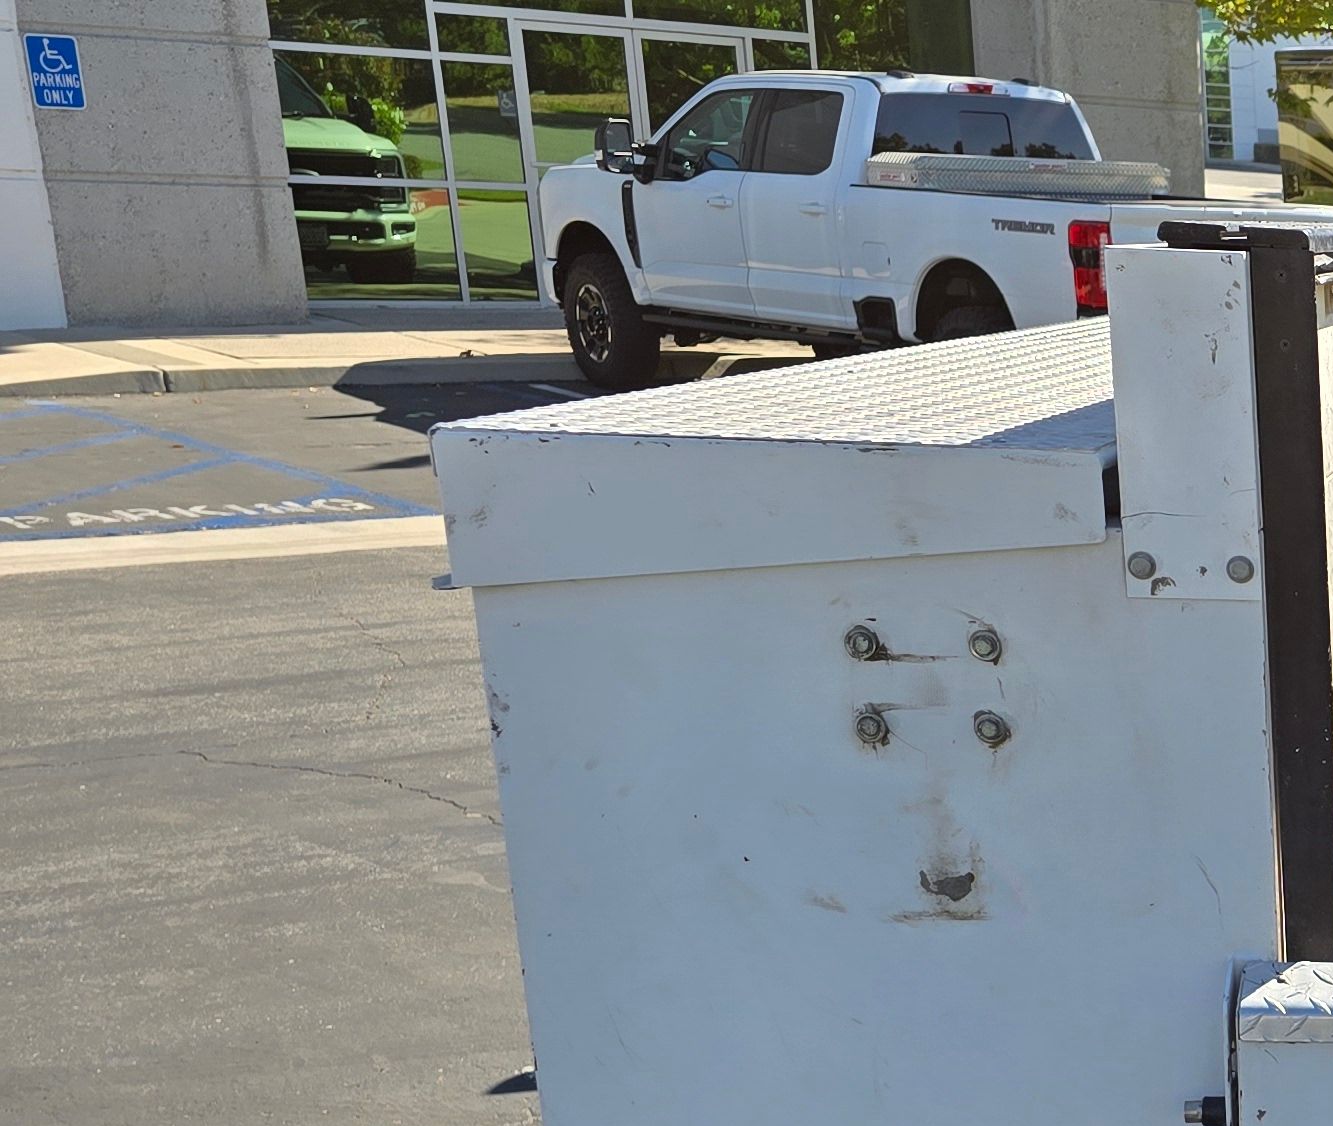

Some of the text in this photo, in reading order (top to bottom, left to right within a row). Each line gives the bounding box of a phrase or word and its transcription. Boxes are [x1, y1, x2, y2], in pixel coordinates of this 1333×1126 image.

[33, 72, 80, 88] PARKING
[43, 89, 74, 104] ONLY
[991, 218, 1055, 235] TREMOR
[0, 498, 375, 529] PARKING
